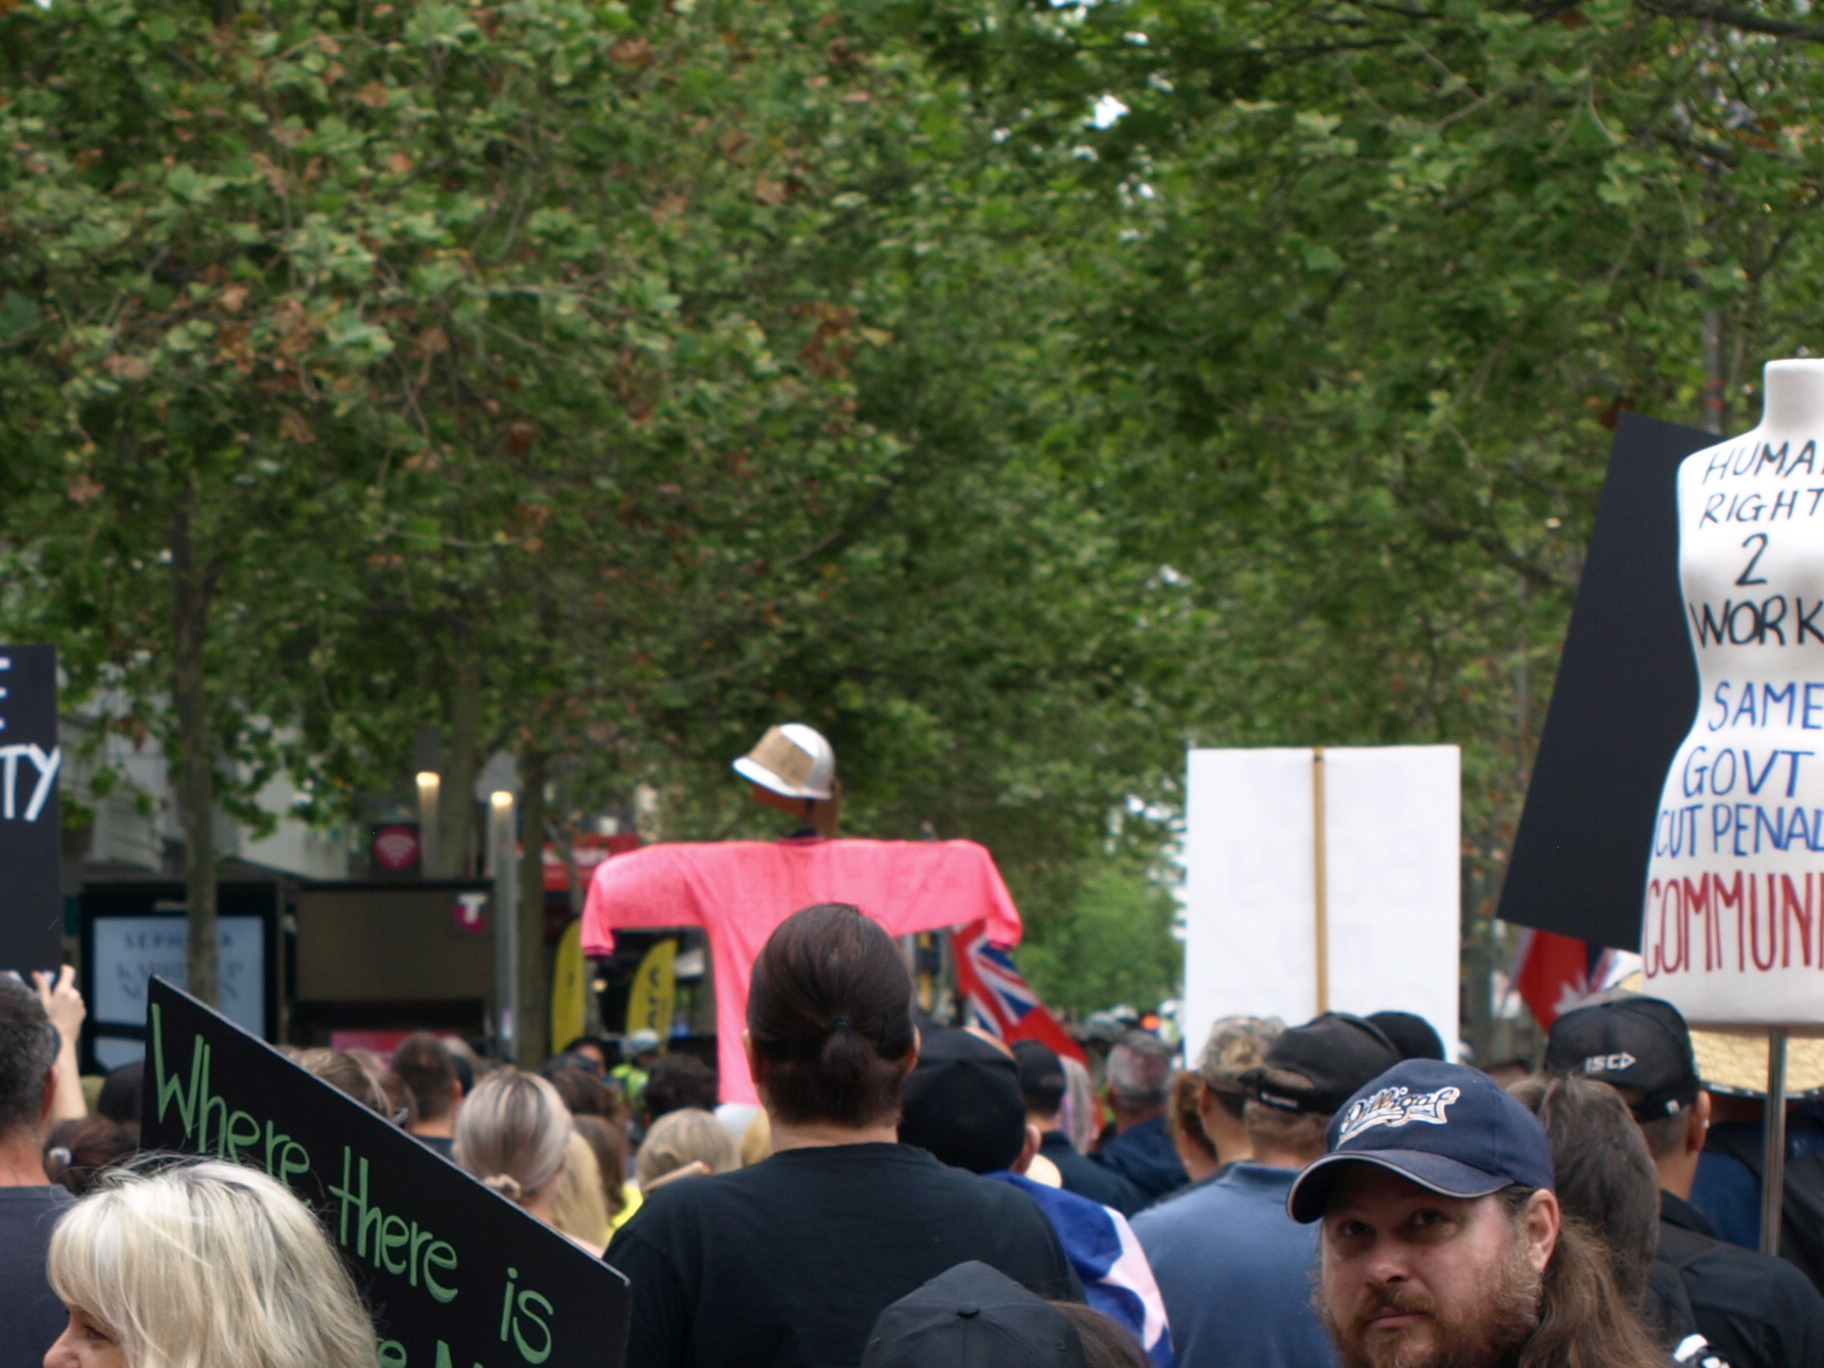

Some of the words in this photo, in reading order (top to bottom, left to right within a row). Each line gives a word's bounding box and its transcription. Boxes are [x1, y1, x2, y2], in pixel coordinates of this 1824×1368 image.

[1702, 439, 1824, 485] HUMA
[1734, 532, 1768, 587] 2
[1688, 594, 1824, 649] WORK
[1708, 681, 1824, 732] SAME
[1683, 745, 1815, 798] GOVT
[1653, 804, 1704, 859] CUT
[151, 1002, 313, 1208] Where
[328, 1146, 459, 1303] there
[499, 1268, 555, 1365] is
